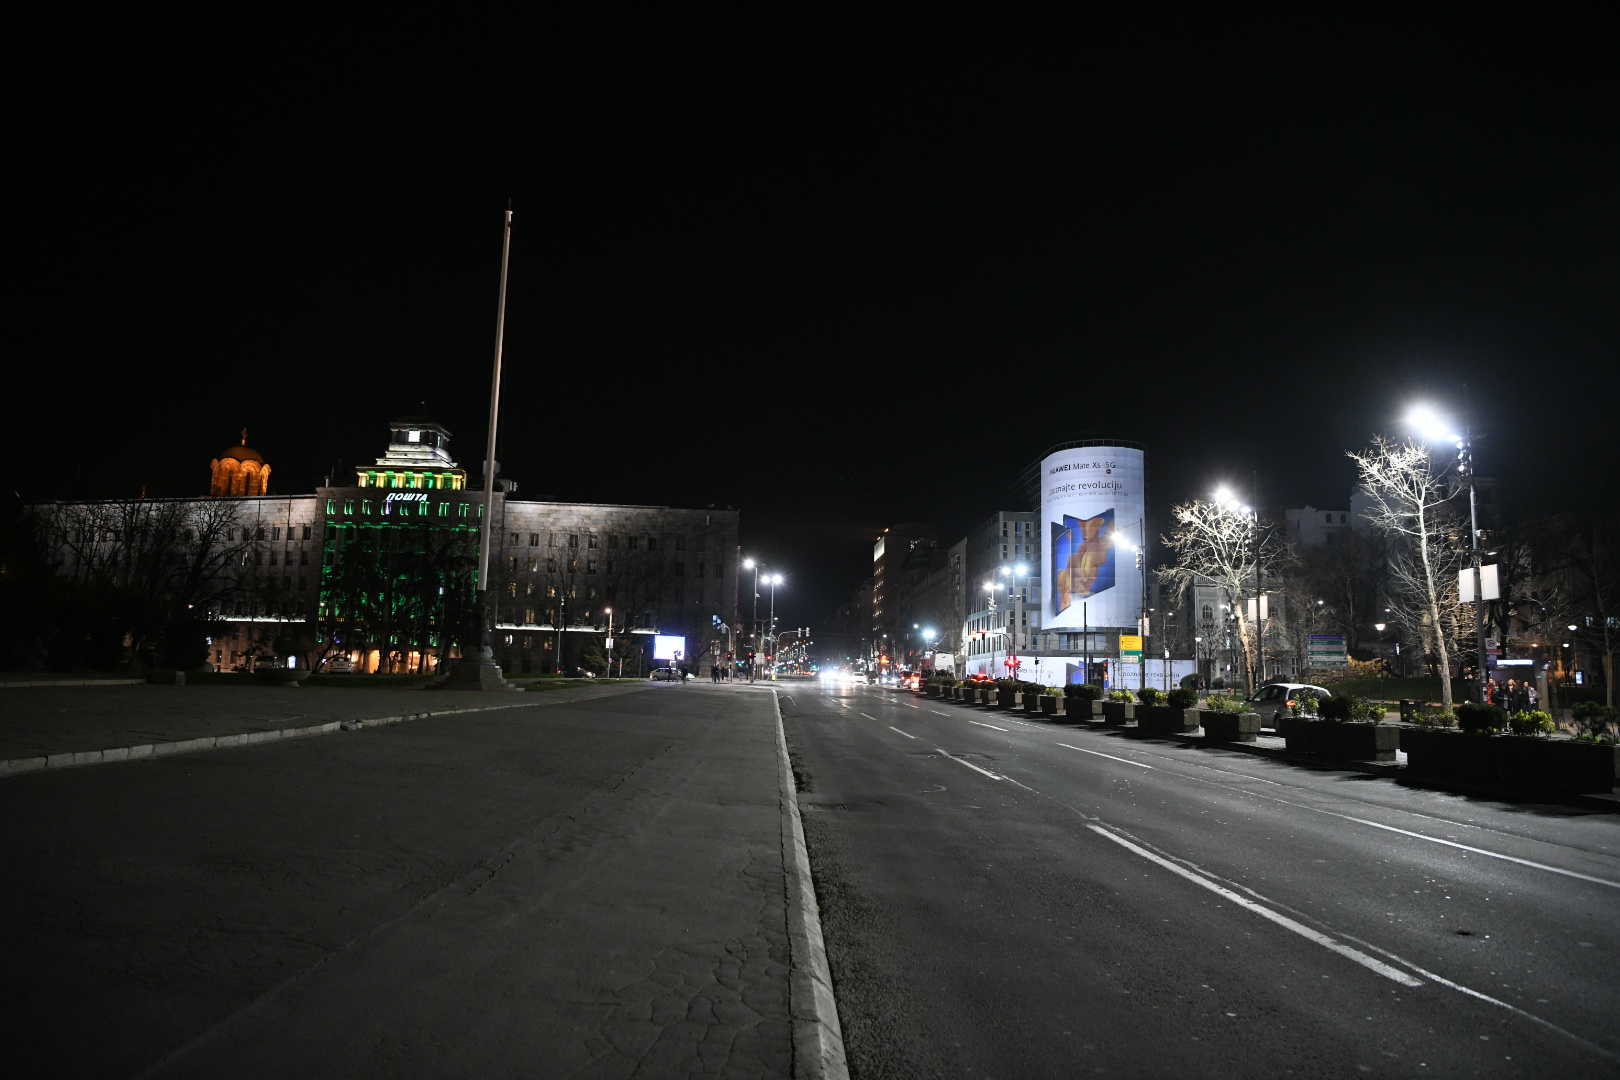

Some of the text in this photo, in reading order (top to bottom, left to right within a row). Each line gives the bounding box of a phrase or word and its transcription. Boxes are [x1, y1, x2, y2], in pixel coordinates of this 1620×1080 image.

[1105, 461, 1116, 469] 5G
[1078, 481, 1122, 490] revoluciju
[385, 492, 428, 501] ПОШТА
